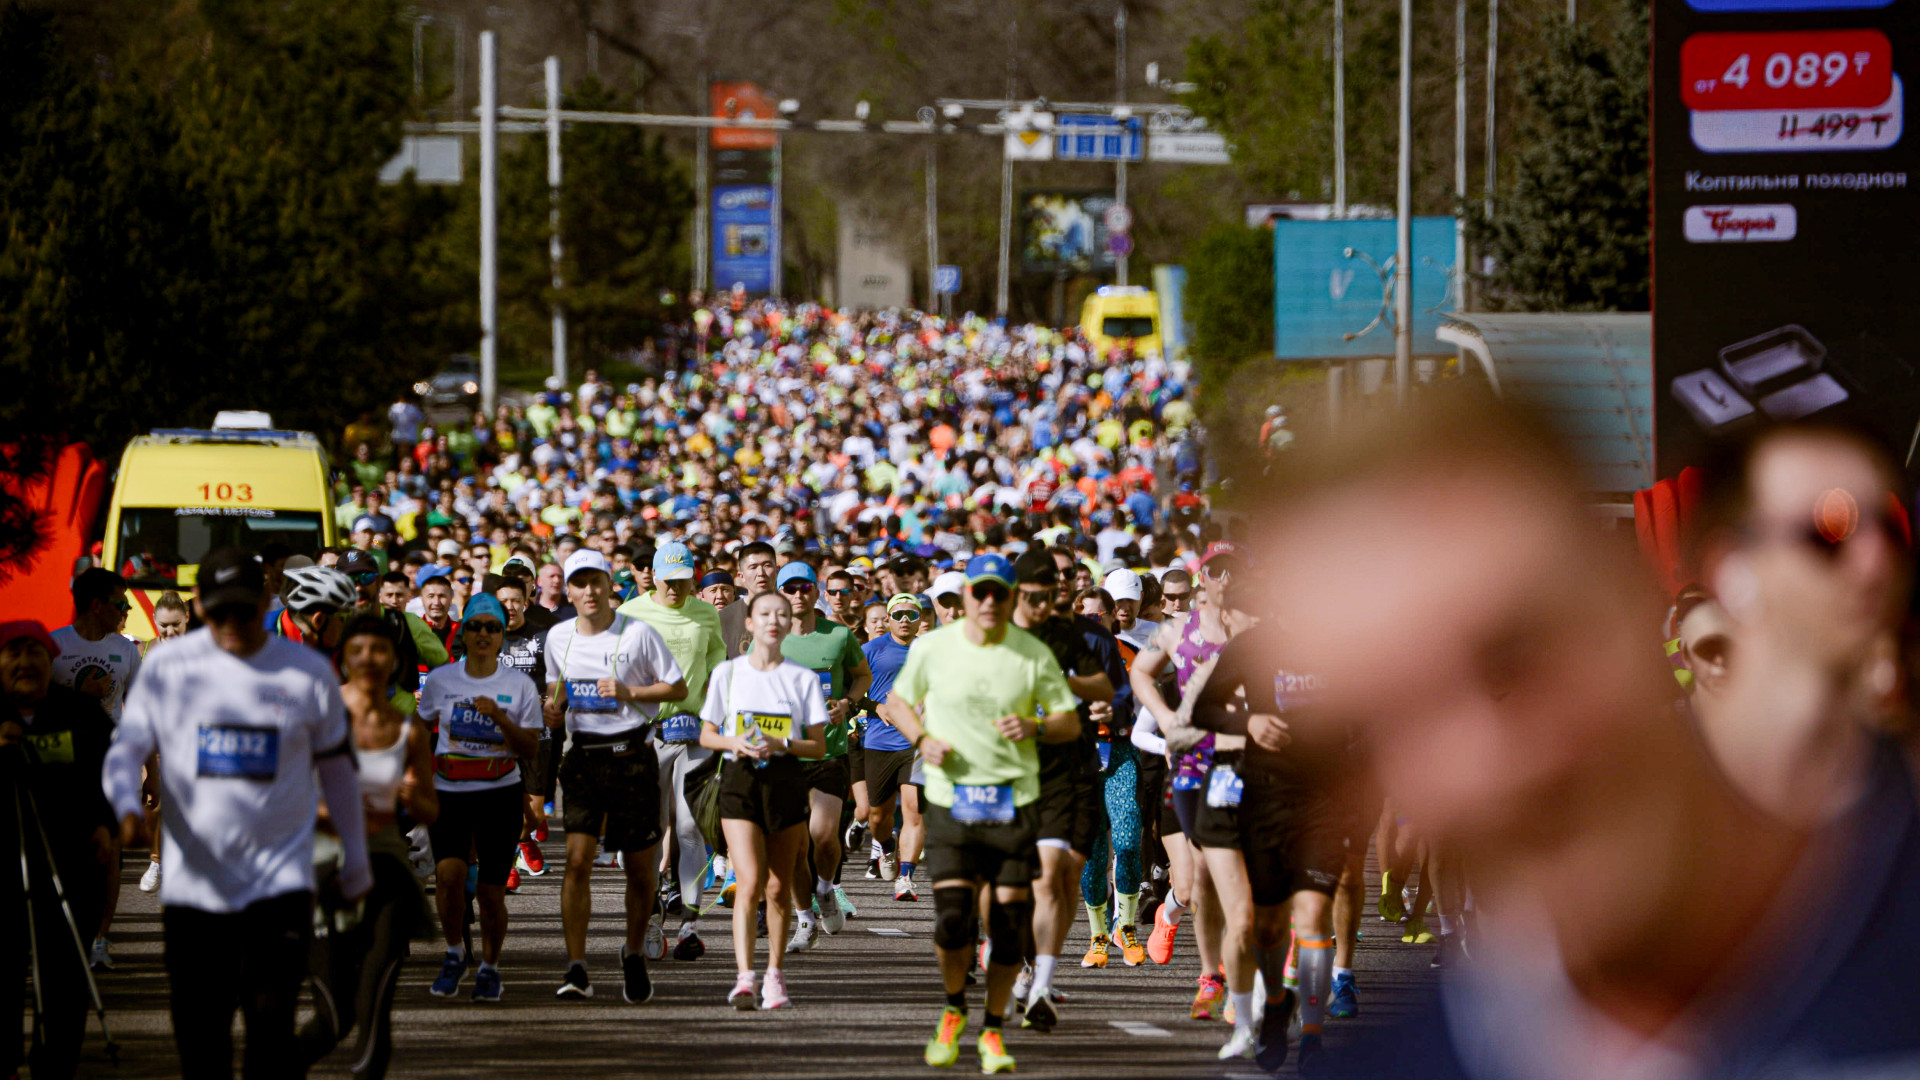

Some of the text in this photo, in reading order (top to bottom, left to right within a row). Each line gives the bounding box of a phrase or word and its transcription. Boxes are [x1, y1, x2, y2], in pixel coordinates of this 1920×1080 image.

[1722, 53, 1751, 89] 4
[1764, 51, 1848, 88] 089
[1811, 113, 1861, 139] 499
[1685, 170, 1908, 191] Коптильня походная
[199, 483, 254, 501] 103
[70, 656, 116, 674] KOSTANAY
[571, 683, 602, 698] 202
[670, 715, 696, 729] 2174
[965, 786, 998, 804] 142
